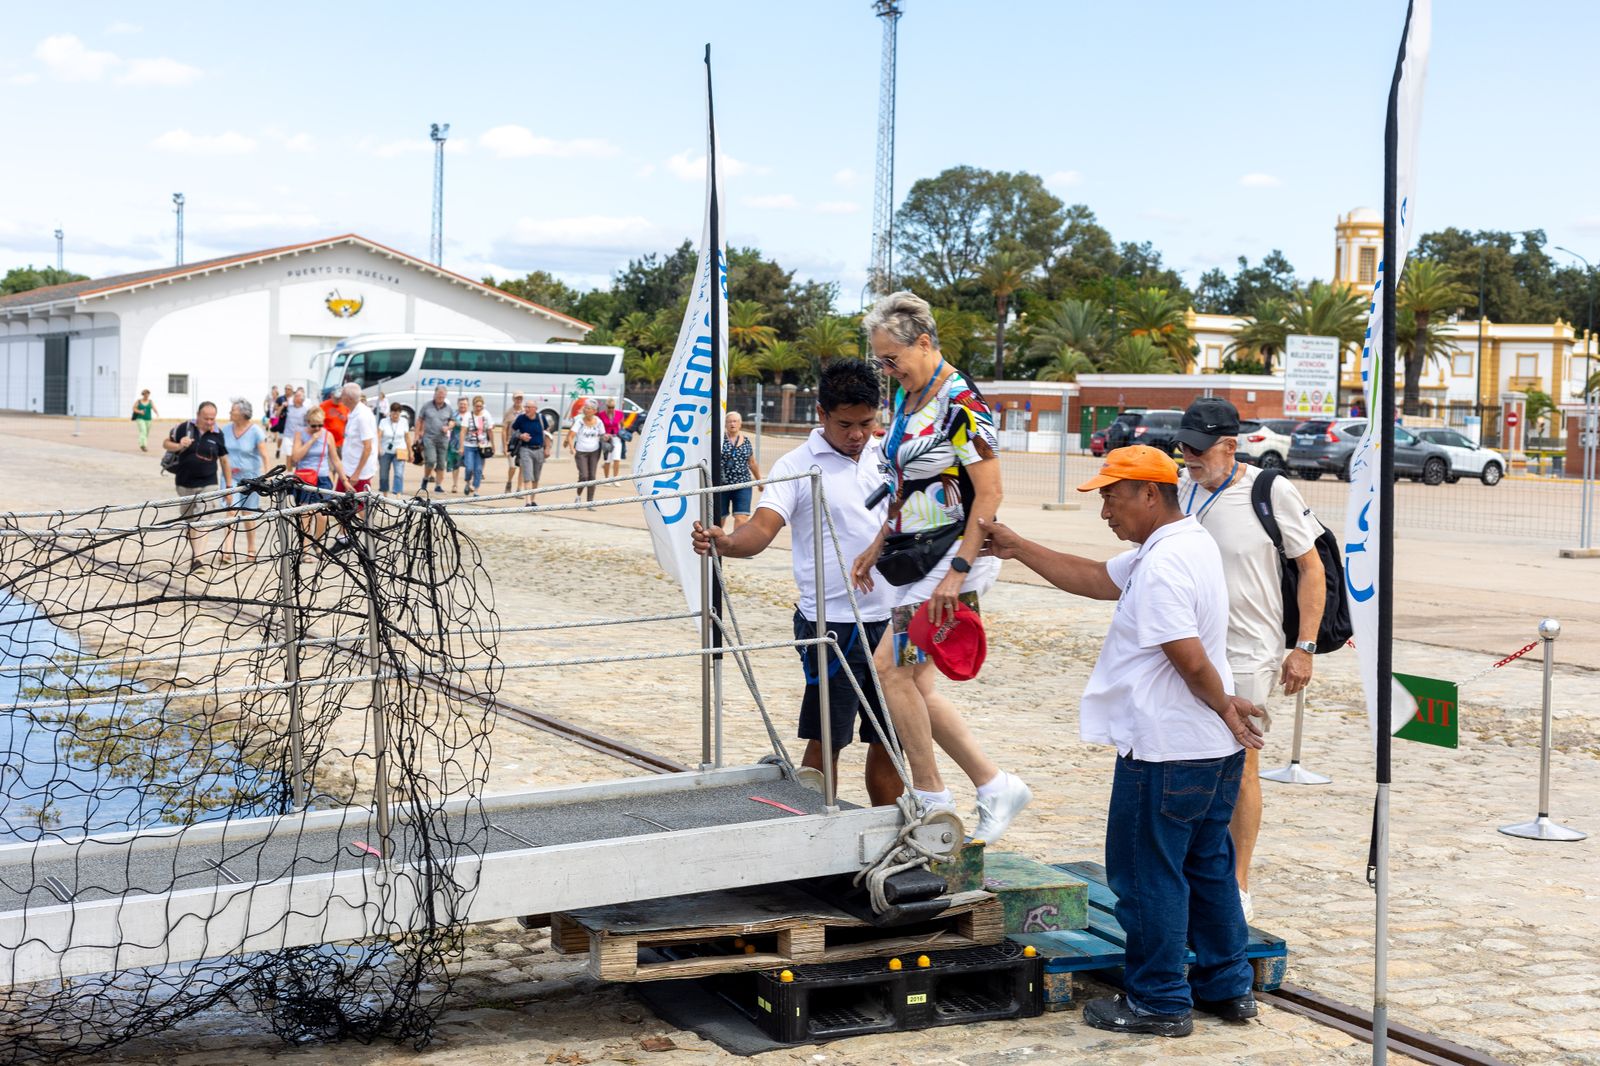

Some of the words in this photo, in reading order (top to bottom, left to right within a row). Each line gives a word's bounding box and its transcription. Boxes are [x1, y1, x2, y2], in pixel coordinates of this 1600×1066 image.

[287, 266, 332, 277] PUERTO
[337, 266, 351, 274] DE
[357, 269, 400, 285] HUELVA
[1409, 695, 1455, 727] XIT
